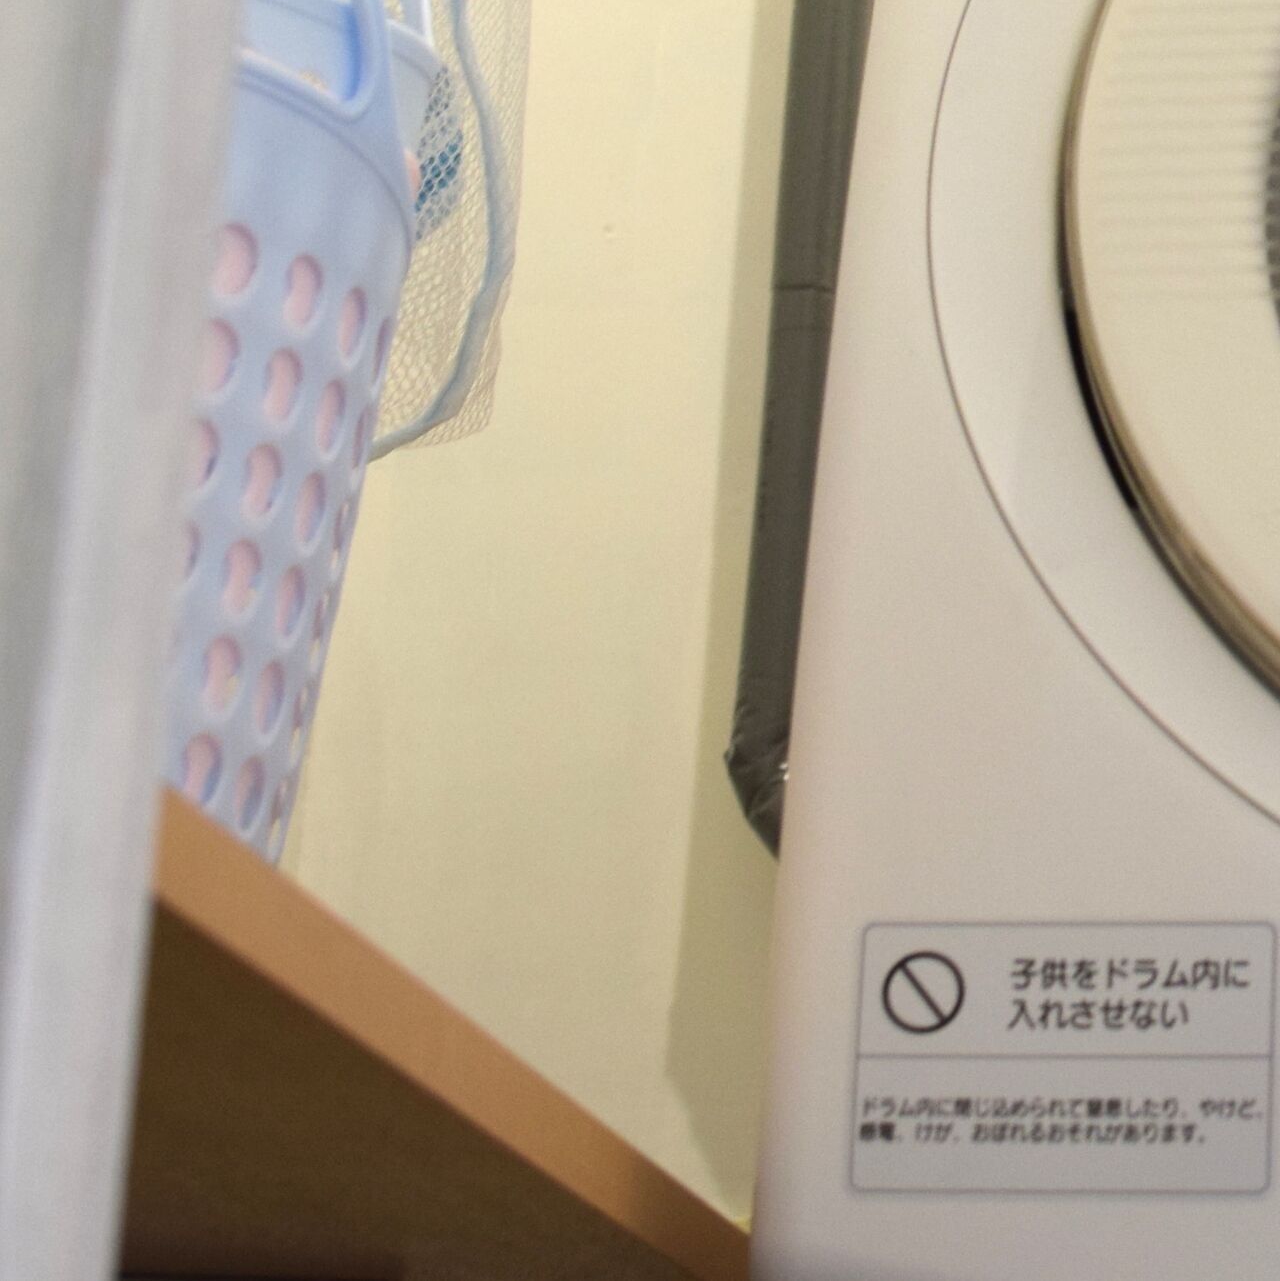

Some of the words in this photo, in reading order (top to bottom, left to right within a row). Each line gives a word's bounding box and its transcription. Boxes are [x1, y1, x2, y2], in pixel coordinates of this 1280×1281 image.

[1009, 957, 1251, 990] 子供をドラム内に
[1007, 998, 1189, 1030] 入れさせない
